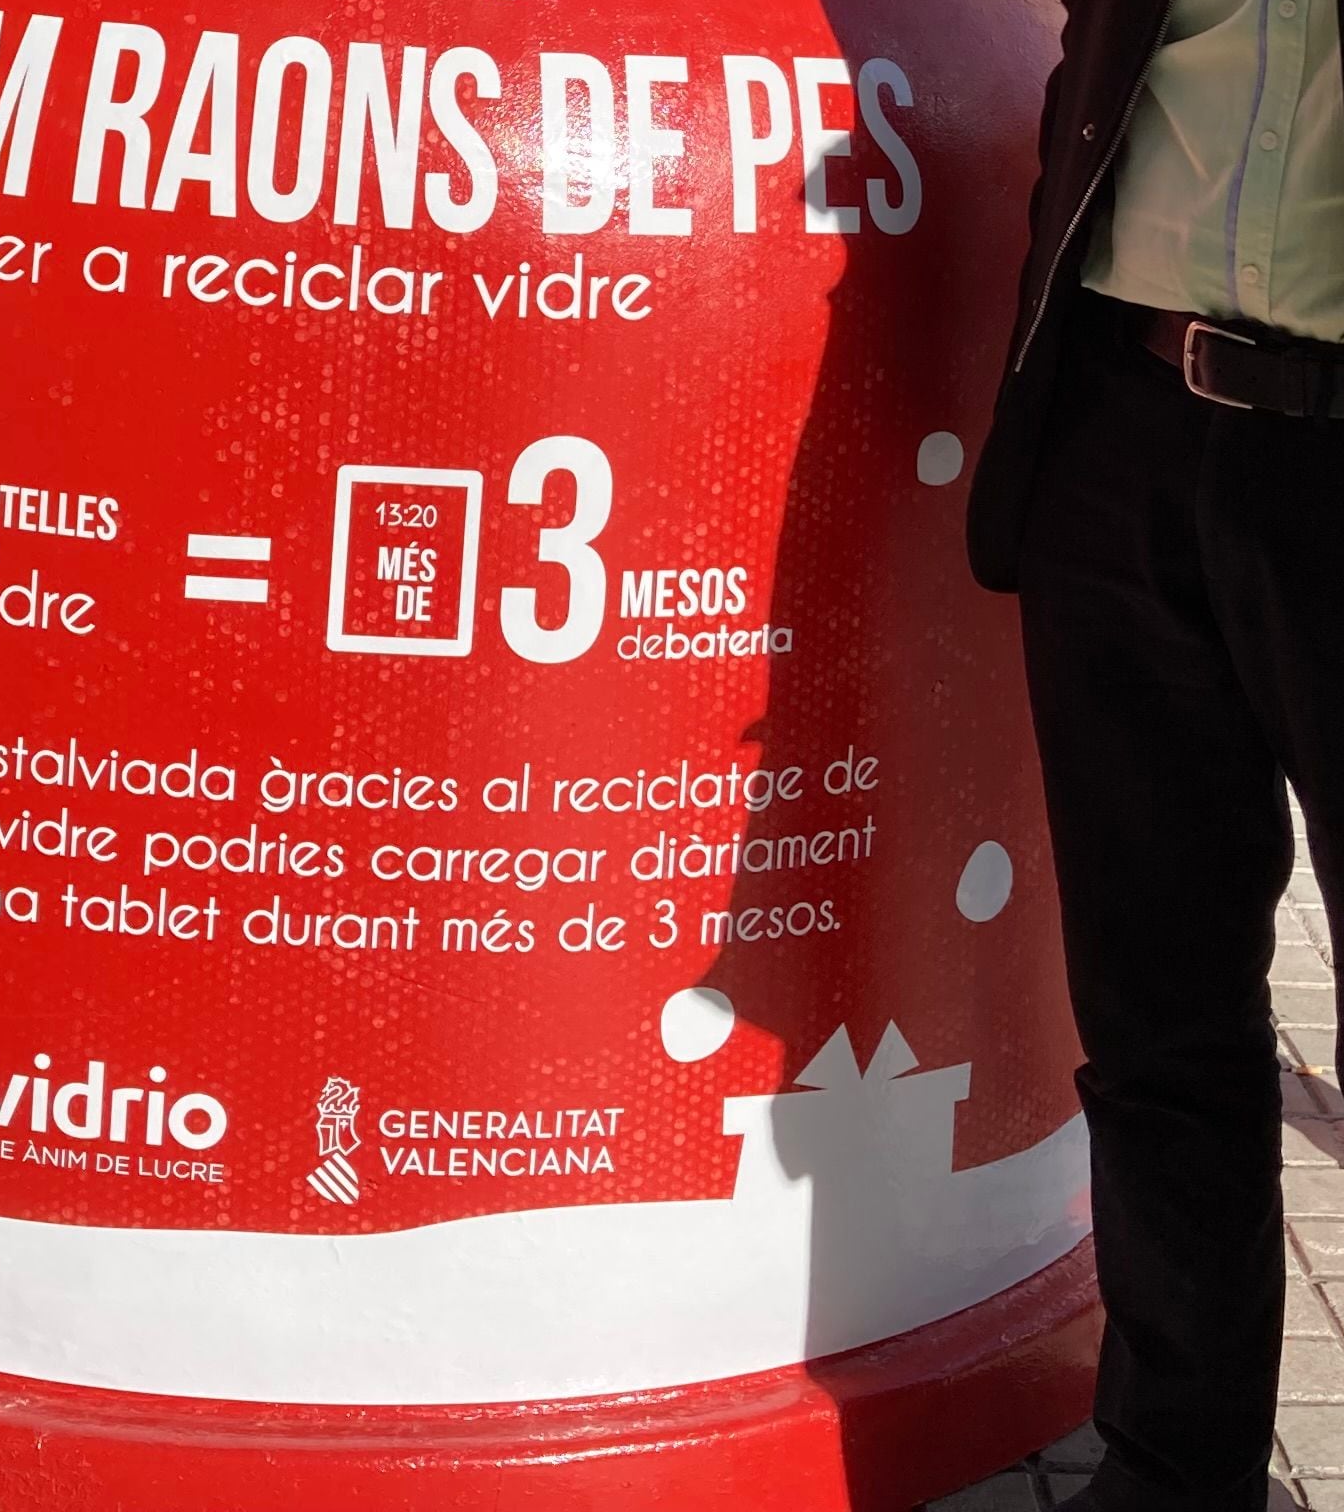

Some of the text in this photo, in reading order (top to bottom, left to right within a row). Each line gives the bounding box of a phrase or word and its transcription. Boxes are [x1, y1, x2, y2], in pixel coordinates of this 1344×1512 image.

[72, 21, 503, 234] RAONS
[539, 51, 693, 237] DE
[722, 54, 923, 236] PES
[83, 246, 129, 293] a
[163, 242, 444, 316] reciclar
[472, 252, 653, 320] vidre
[374, 501, 438, 529] 13:20
[376, 541, 437, 584] MÉS
[500, 435, 613, 665] 3
[395, 584, 432, 622] DE
[619, 566, 748, 620] MESOS
[482, 763, 530, 813] al
[553, 759, 804, 814] reciclatge
[823, 744, 880, 796] de
[143, 823, 345, 877] podries
[370, 840, 606, 892] carregar
[630, 814, 877, 881] diàriament
[61, 883, 221, 942] tablet
[242, 895, 420, 951] durant
[441, 908, 535, 954] més
[558, 902, 626, 954] de
[649, 899, 679, 949] 3
[700, 897, 841, 946] mesos.
[378, 1107, 625, 1140] GENERALITAT
[22, 1140, 88, 1171] ÀNIM
[95, 1153, 130, 1176] DE
[137, 1156, 225, 1184] LUCRE
[379, 1146, 615, 1177] VALENCIANA
